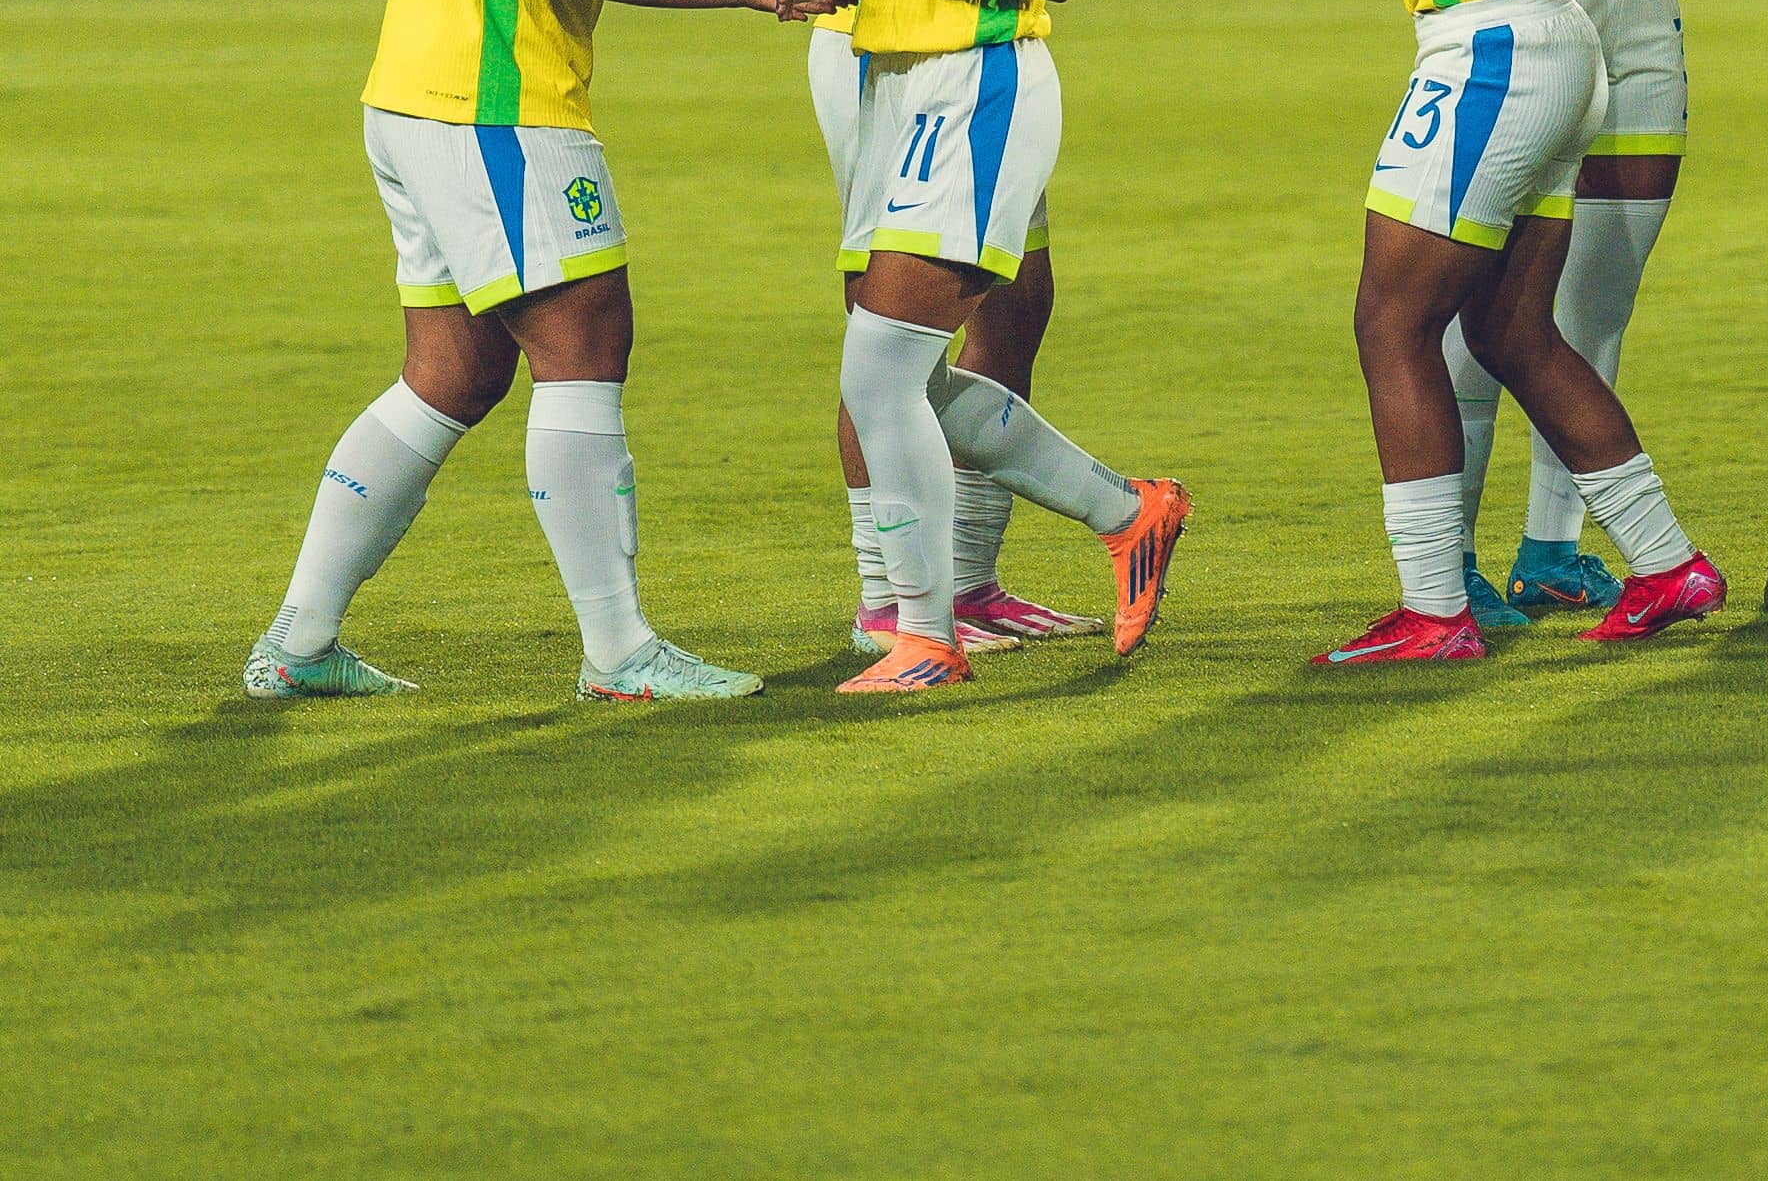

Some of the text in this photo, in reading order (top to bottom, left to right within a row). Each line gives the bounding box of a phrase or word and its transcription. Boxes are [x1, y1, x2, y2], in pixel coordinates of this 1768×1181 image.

[900, 113, 946, 183] 11
[1389, 77, 1452, 149] 13
[575, 223, 611, 240] BRASIL
